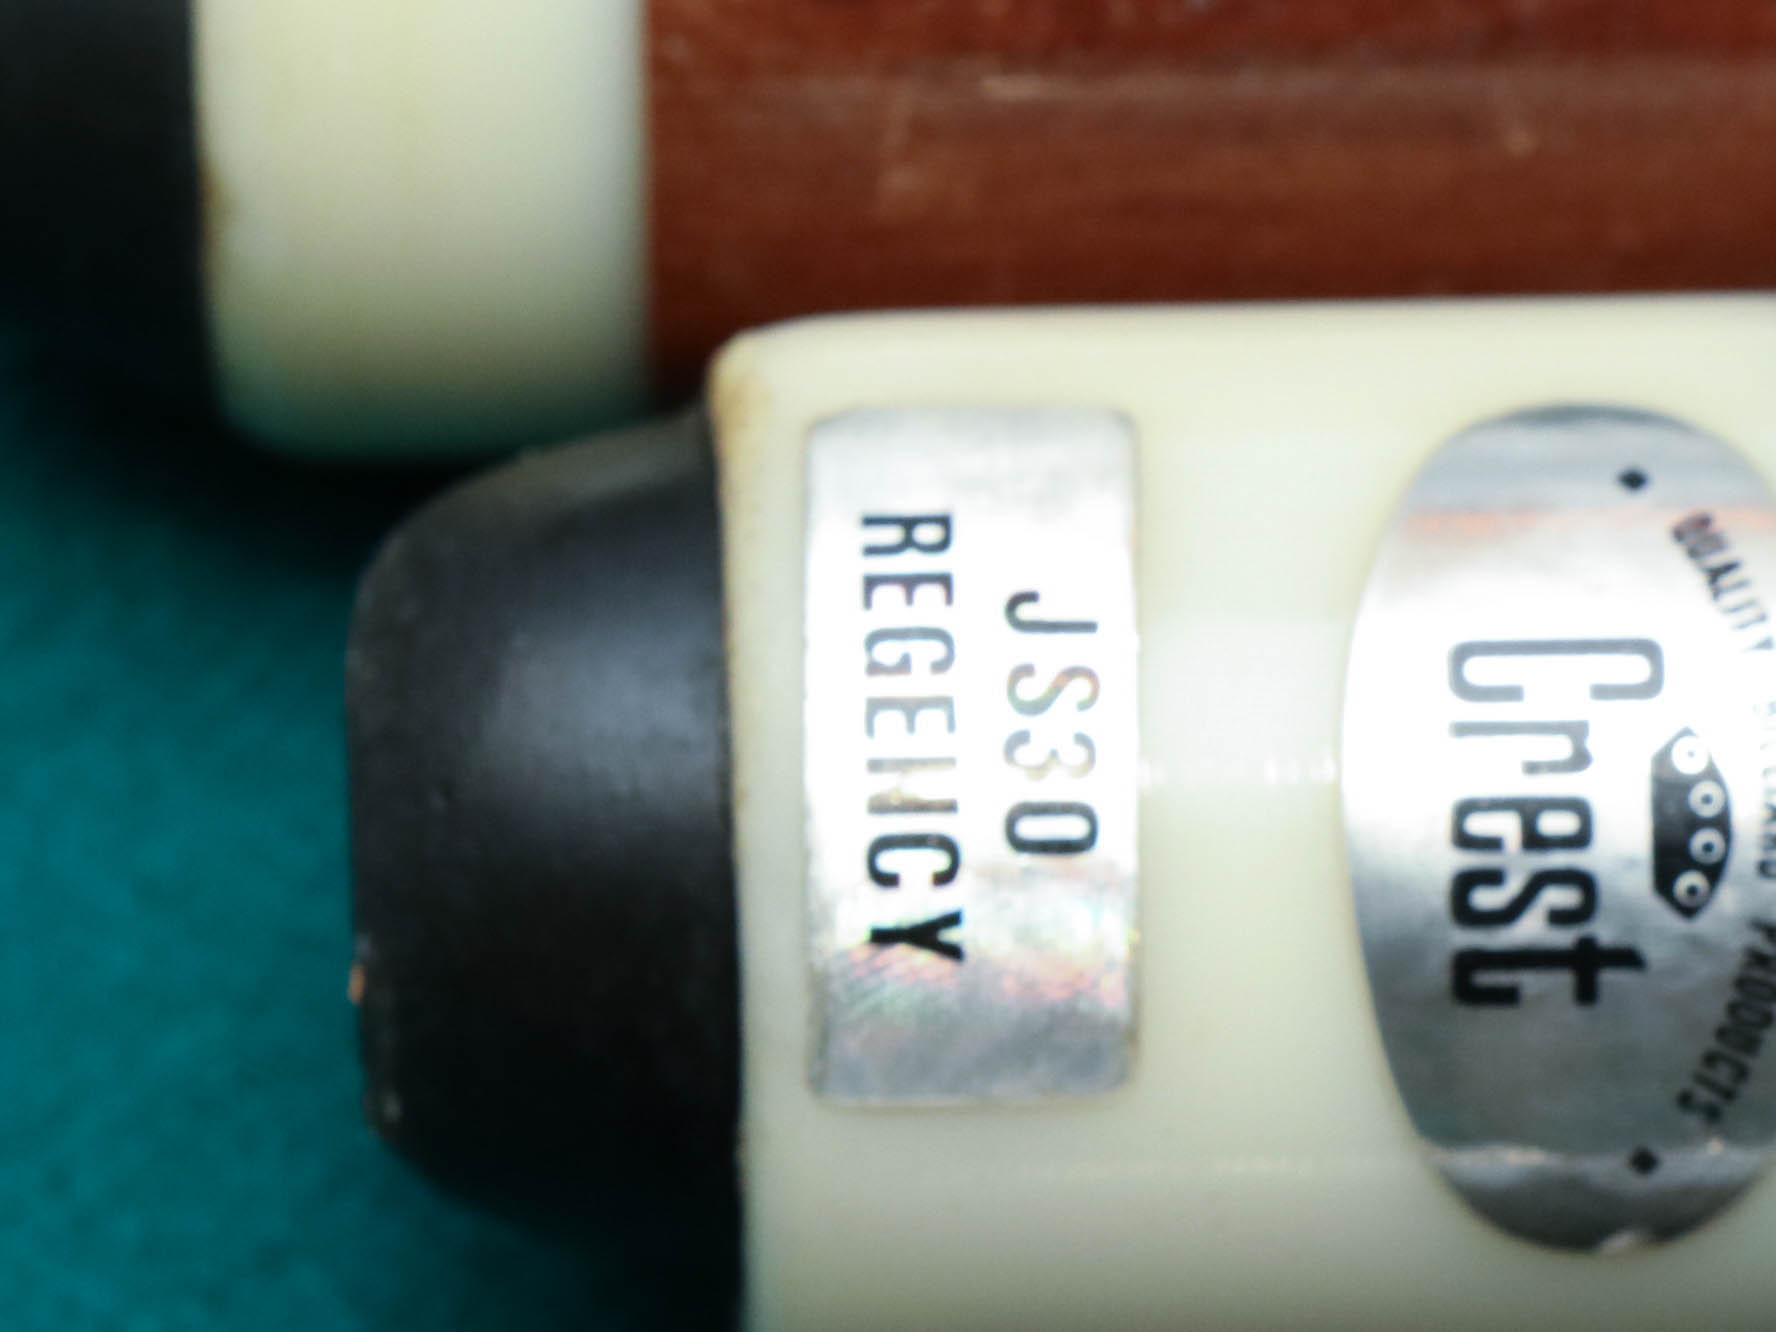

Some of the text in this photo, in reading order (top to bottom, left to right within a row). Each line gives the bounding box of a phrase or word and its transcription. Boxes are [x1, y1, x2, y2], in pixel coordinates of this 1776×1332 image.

[860, 512, 965, 963] REGENCY
[1003, 590, 1101, 857] JS30
[1671, 512, 1776, 653] QUALITY
[1446, 636, 1665, 1008] Crest
